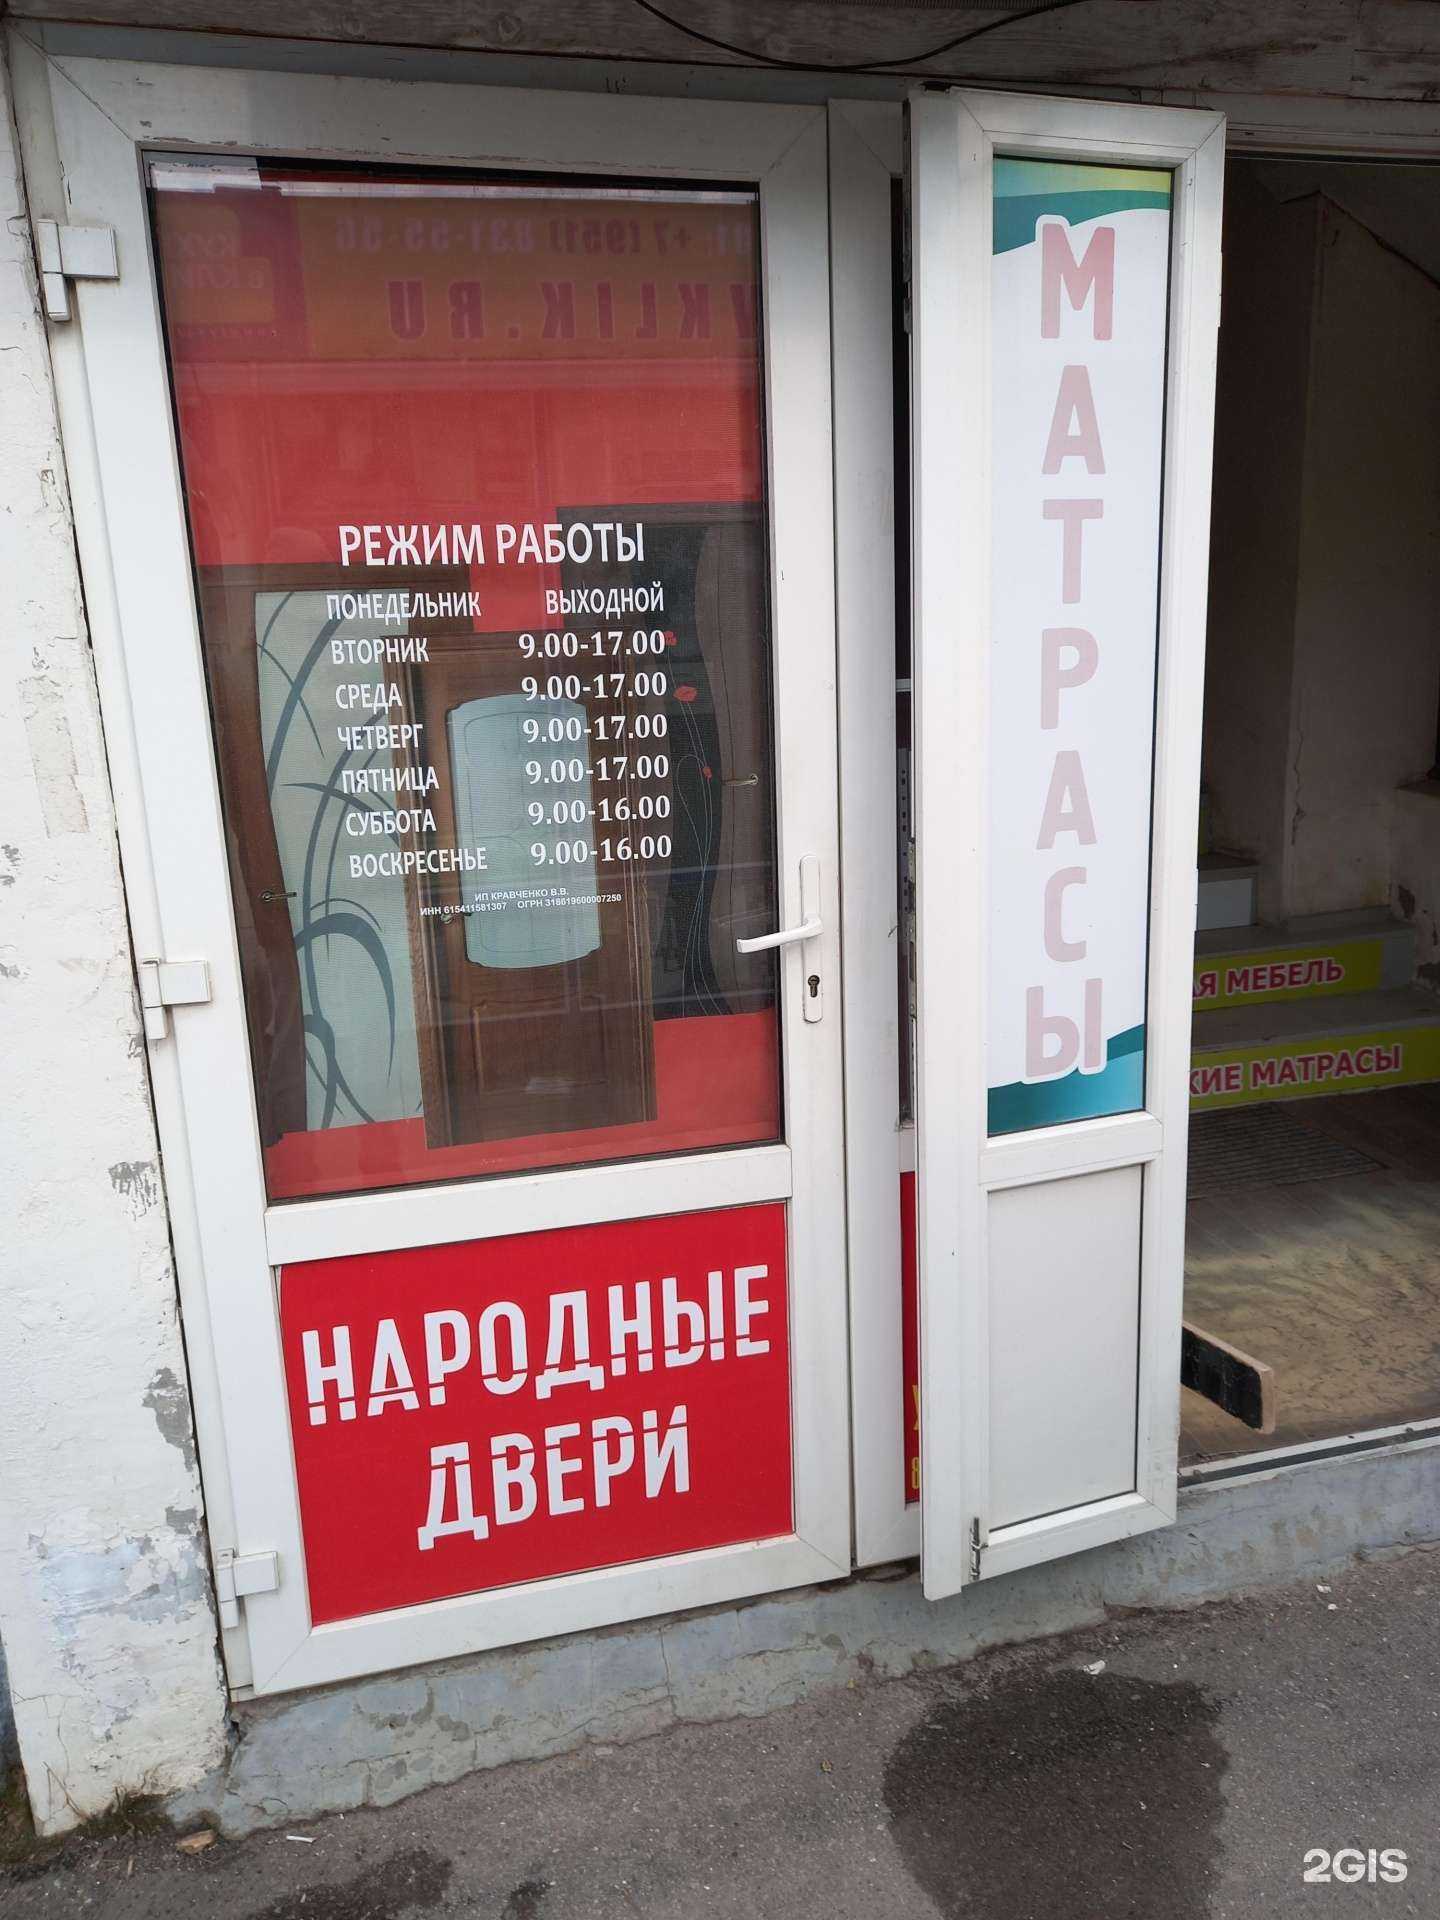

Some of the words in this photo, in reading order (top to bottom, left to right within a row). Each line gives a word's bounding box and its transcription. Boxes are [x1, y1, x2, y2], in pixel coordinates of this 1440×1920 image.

[339, 524, 485, 566] РЕЖИМ
[496, 522, 645, 565] РАБОТЫ
[326, 591, 481, 625] ПОНЕДЕЛЬНИК
[545, 581, 664, 619] ВЫХОДНОЙ
[331, 637, 430, 664] ВТОРНИК
[518, 630, 666, 659] 9.00-17.00
[1025, 222, 1116, 1079] МАТРАСЫ
[335, 682, 403, 716] СРЕДА
[521, 672, 668, 701] 9.00-17.00
[337, 724, 423, 751] ЧЕТВЕРГ
[522, 714, 669, 743] 9.00-17.00
[341, 766, 440, 796] ПЯТНИЦА
[525, 755, 670, 784] 9.00-17.00
[345, 808, 437, 837] СУББОТА
[528, 795, 671, 825] 9.00-16.00
[349, 847, 488, 878] ВОСКРЕСЕНЬЕ
[530, 835, 673, 865] 9.00-16.00
[420, 906, 442, 917] ИНН
[444, 902, 507, 915] 615411581307
[518, 899, 543, 909] ОГРН
[475, 893, 489, 902] ИП
[491, 889, 549, 901] КРАВЧЕНКО
[551, 887, 569, 897] В.В.
[1226, 958, 1344, 994] МЕБЕЛЬ
[1252, 1045, 1401, 1088] МАТРАСЫ
[302, 1264, 770, 1426] НАРОДНЫЕ
[418, 1404, 690, 1551] ДВЕРИ
